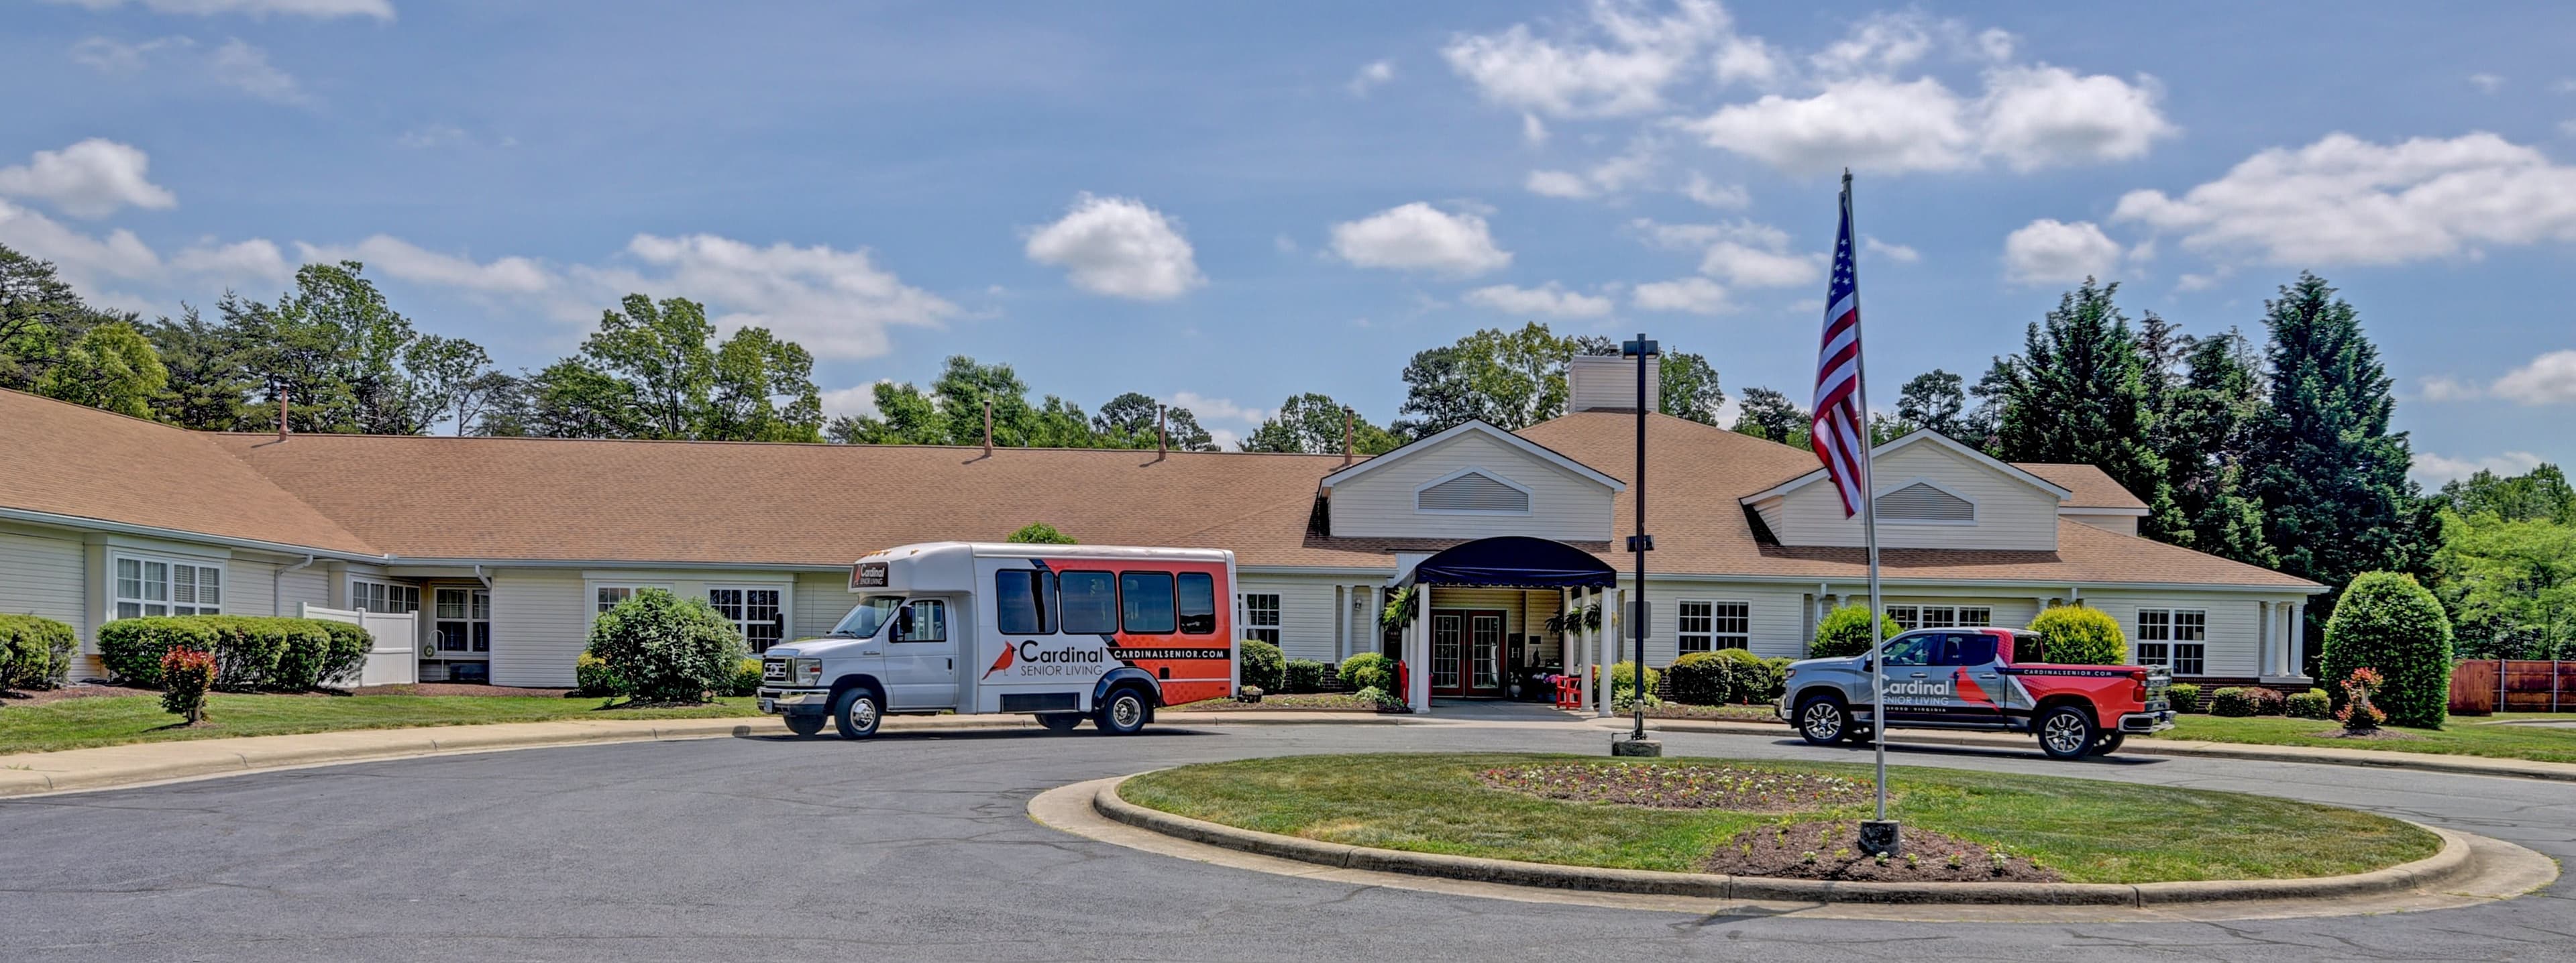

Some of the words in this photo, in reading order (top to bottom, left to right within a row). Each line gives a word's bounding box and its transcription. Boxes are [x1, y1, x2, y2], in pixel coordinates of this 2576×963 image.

[861, 563, 885, 577] Cardinal
[1020, 640, 1103, 663] Cardinal
[1114, 650, 1224, 659] CARDINALSENIOR.COM
[1021, 665, 1062, 676] SENIOR
[1066, 665, 1103, 675] LIVING
[1882, 696, 1912, 704] ENIOR
[1915, 697, 1949, 705] LIVING
